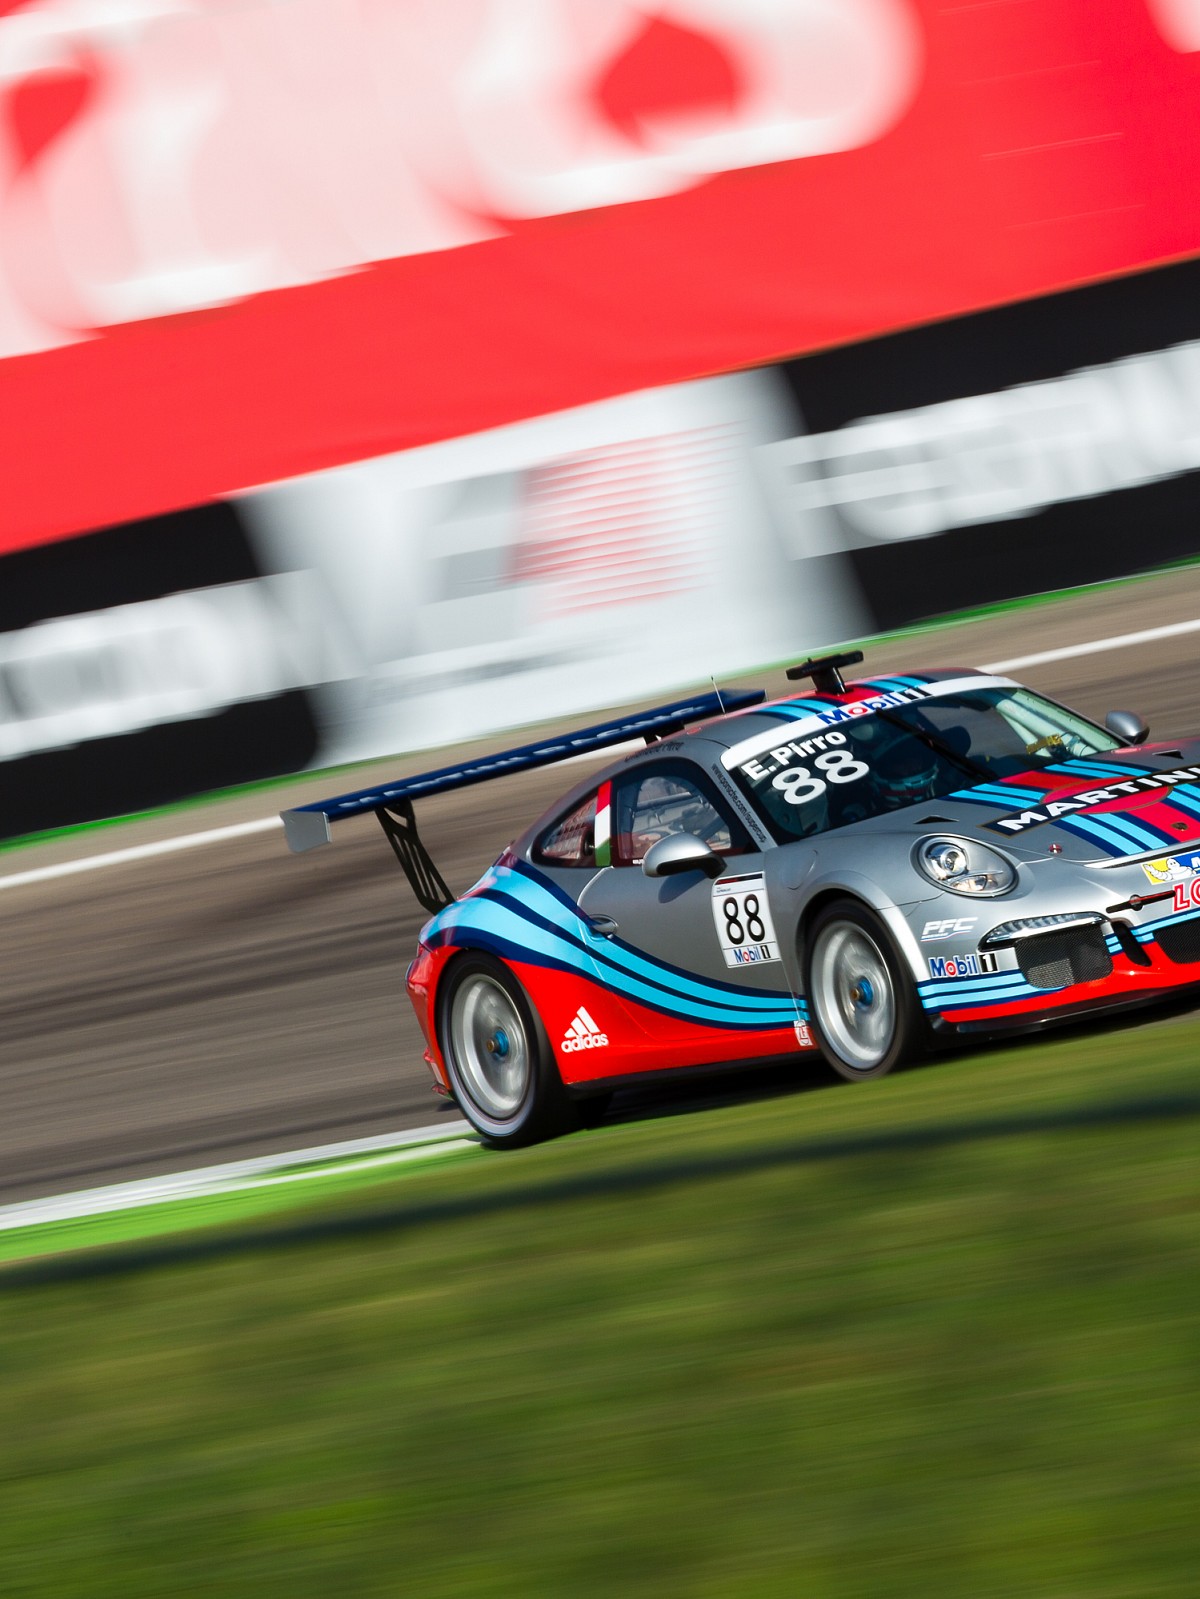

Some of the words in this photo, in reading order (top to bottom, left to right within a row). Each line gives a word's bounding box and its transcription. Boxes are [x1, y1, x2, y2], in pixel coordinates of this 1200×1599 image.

[816, 690, 903, 726] Mobil
[772, 750, 869, 804] 88
[723, 894, 765, 945] 88
[922, 917, 978, 935] PFC
[733, 946, 761, 963] Mobil
[761, 945, 771, 959] 1
[928, 954, 979, 978] Mobil
[981, 953, 996, 973] 1
[561, 1033, 609, 1053] adidas
